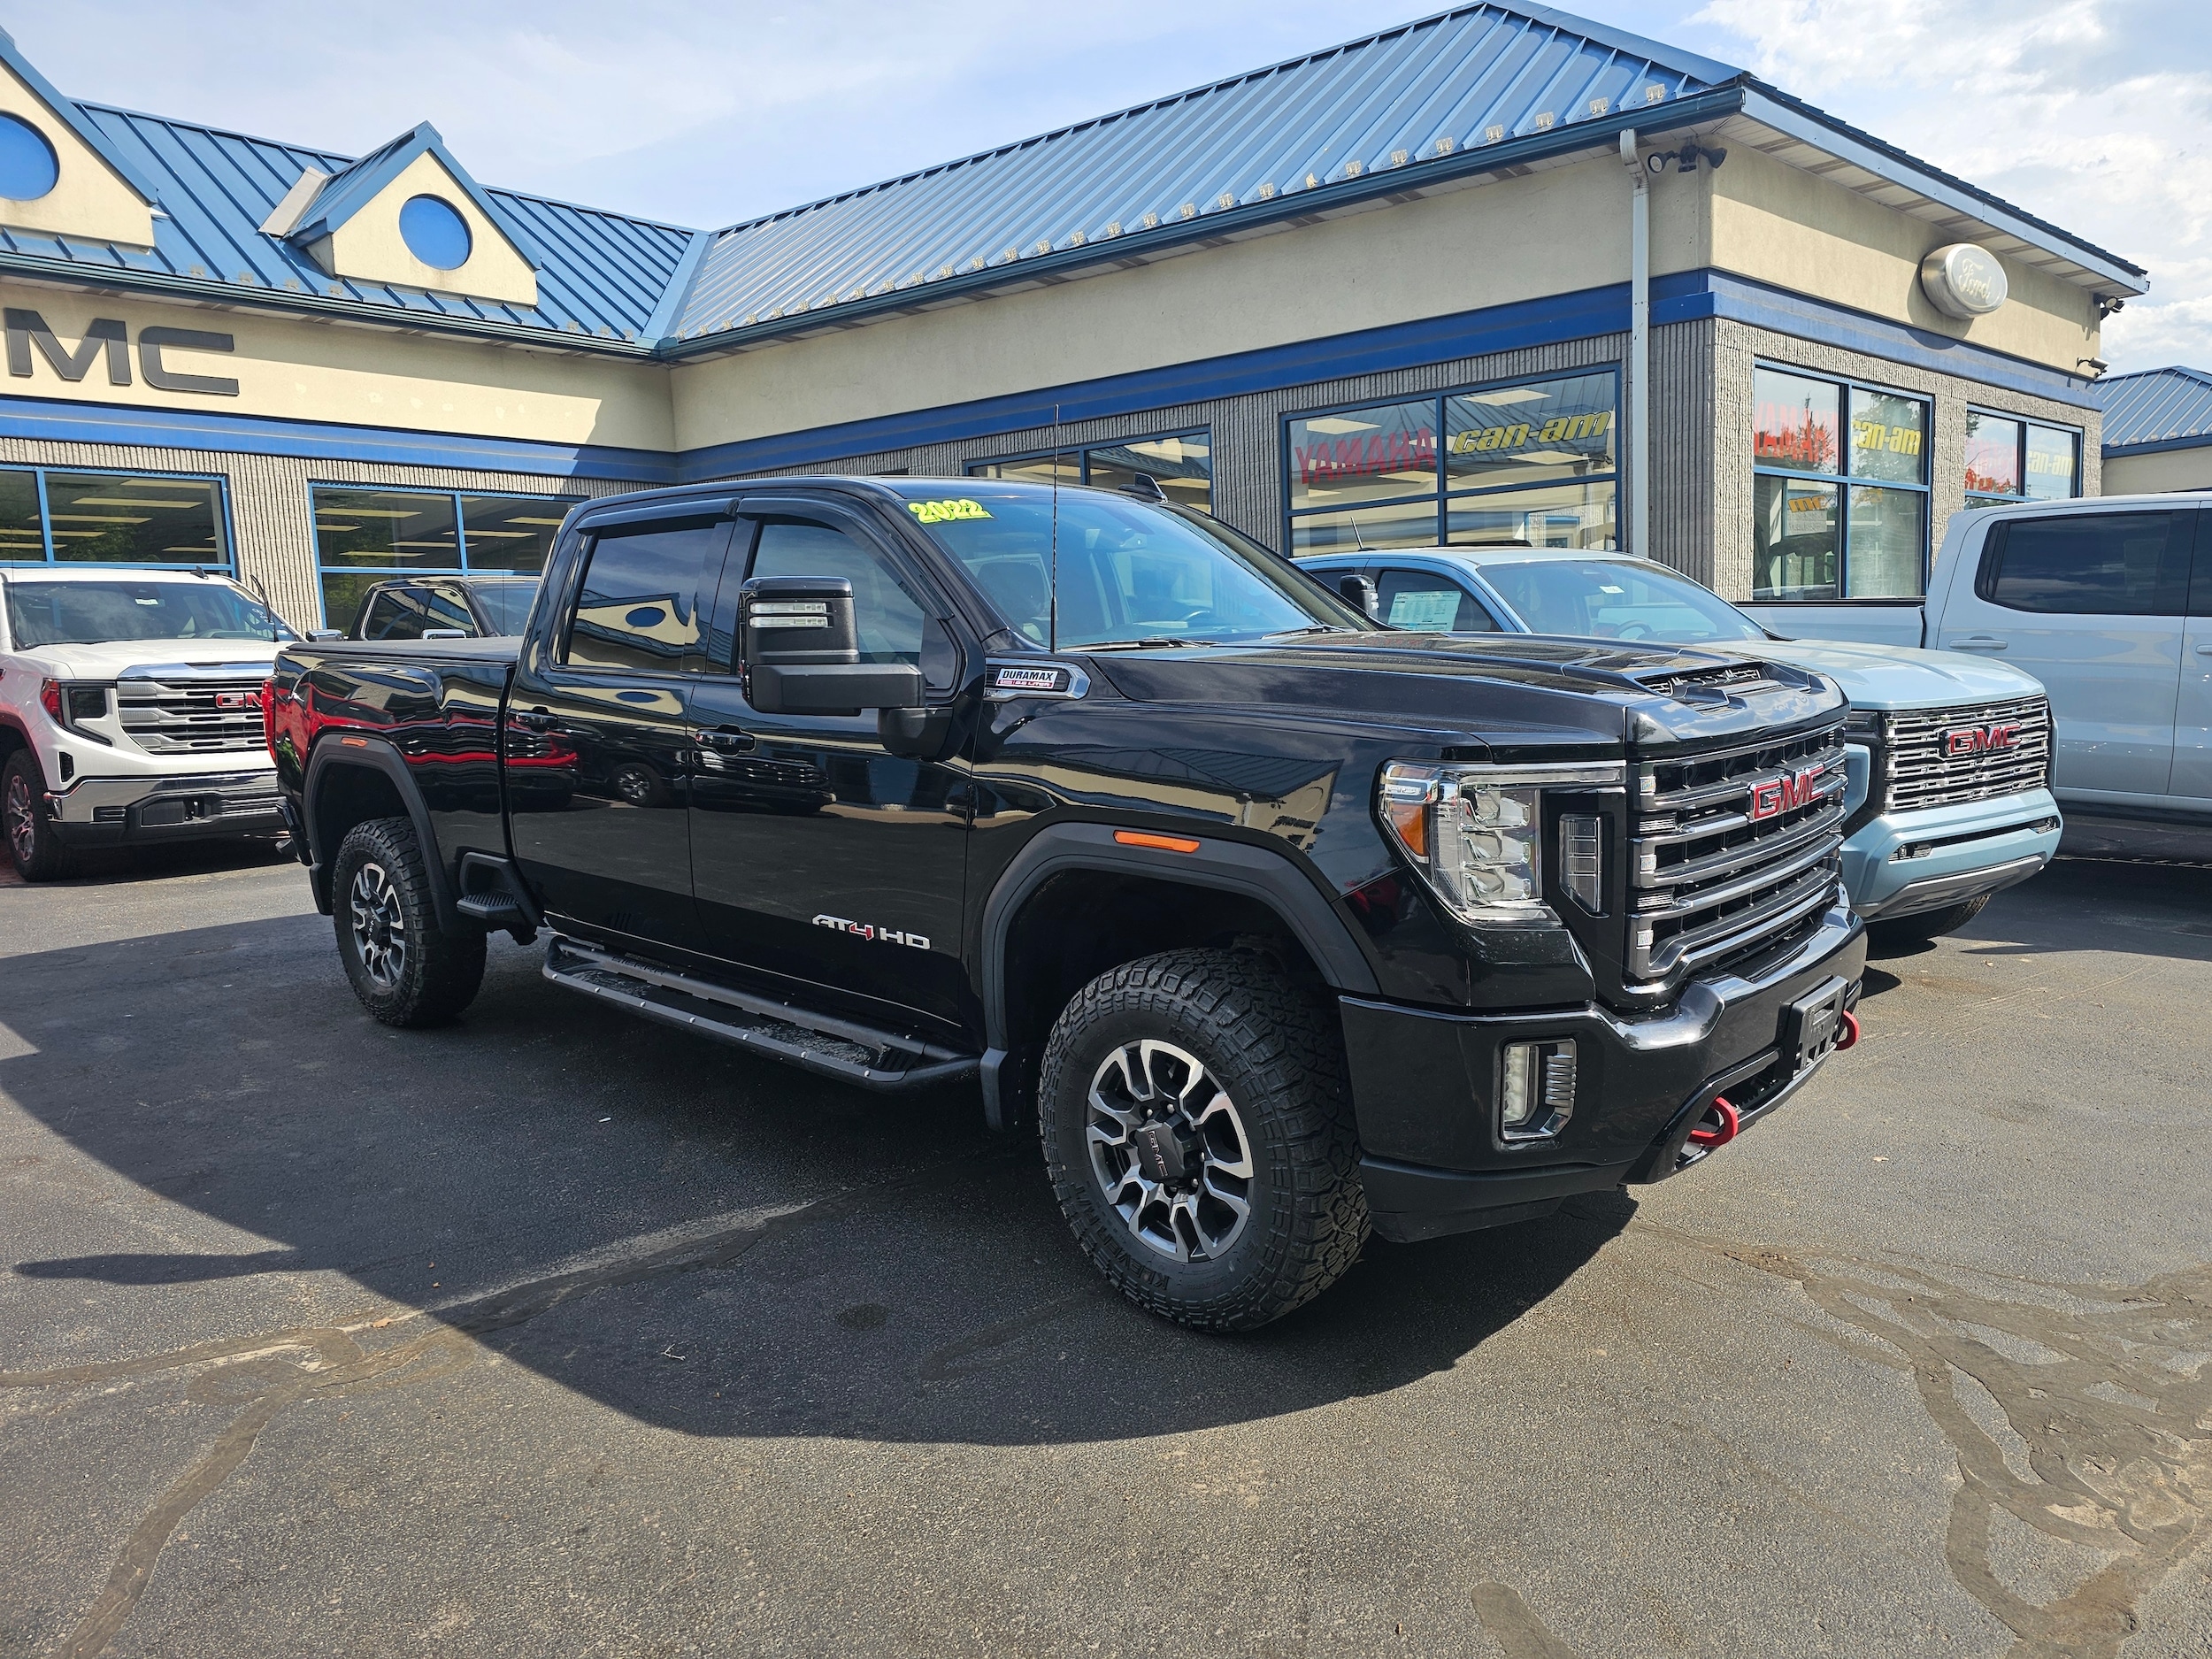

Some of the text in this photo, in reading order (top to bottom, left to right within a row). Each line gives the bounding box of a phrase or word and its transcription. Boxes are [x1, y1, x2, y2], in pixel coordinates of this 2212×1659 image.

[1958, 258, 1991, 299] Ford
[1452, 411, 1611, 455] can-am
[1295, 426, 1436, 485] YAMAHA
[909, 499, 995, 523] 2022
[1002, 670, 1054, 681] DURAMAX
[1947, 723, 2021, 756] GMC
[1750, 763, 1824, 822] GMC
[812, 914, 931, 950] AT4 HD
[1148, 1130, 1168, 1177] GMC
